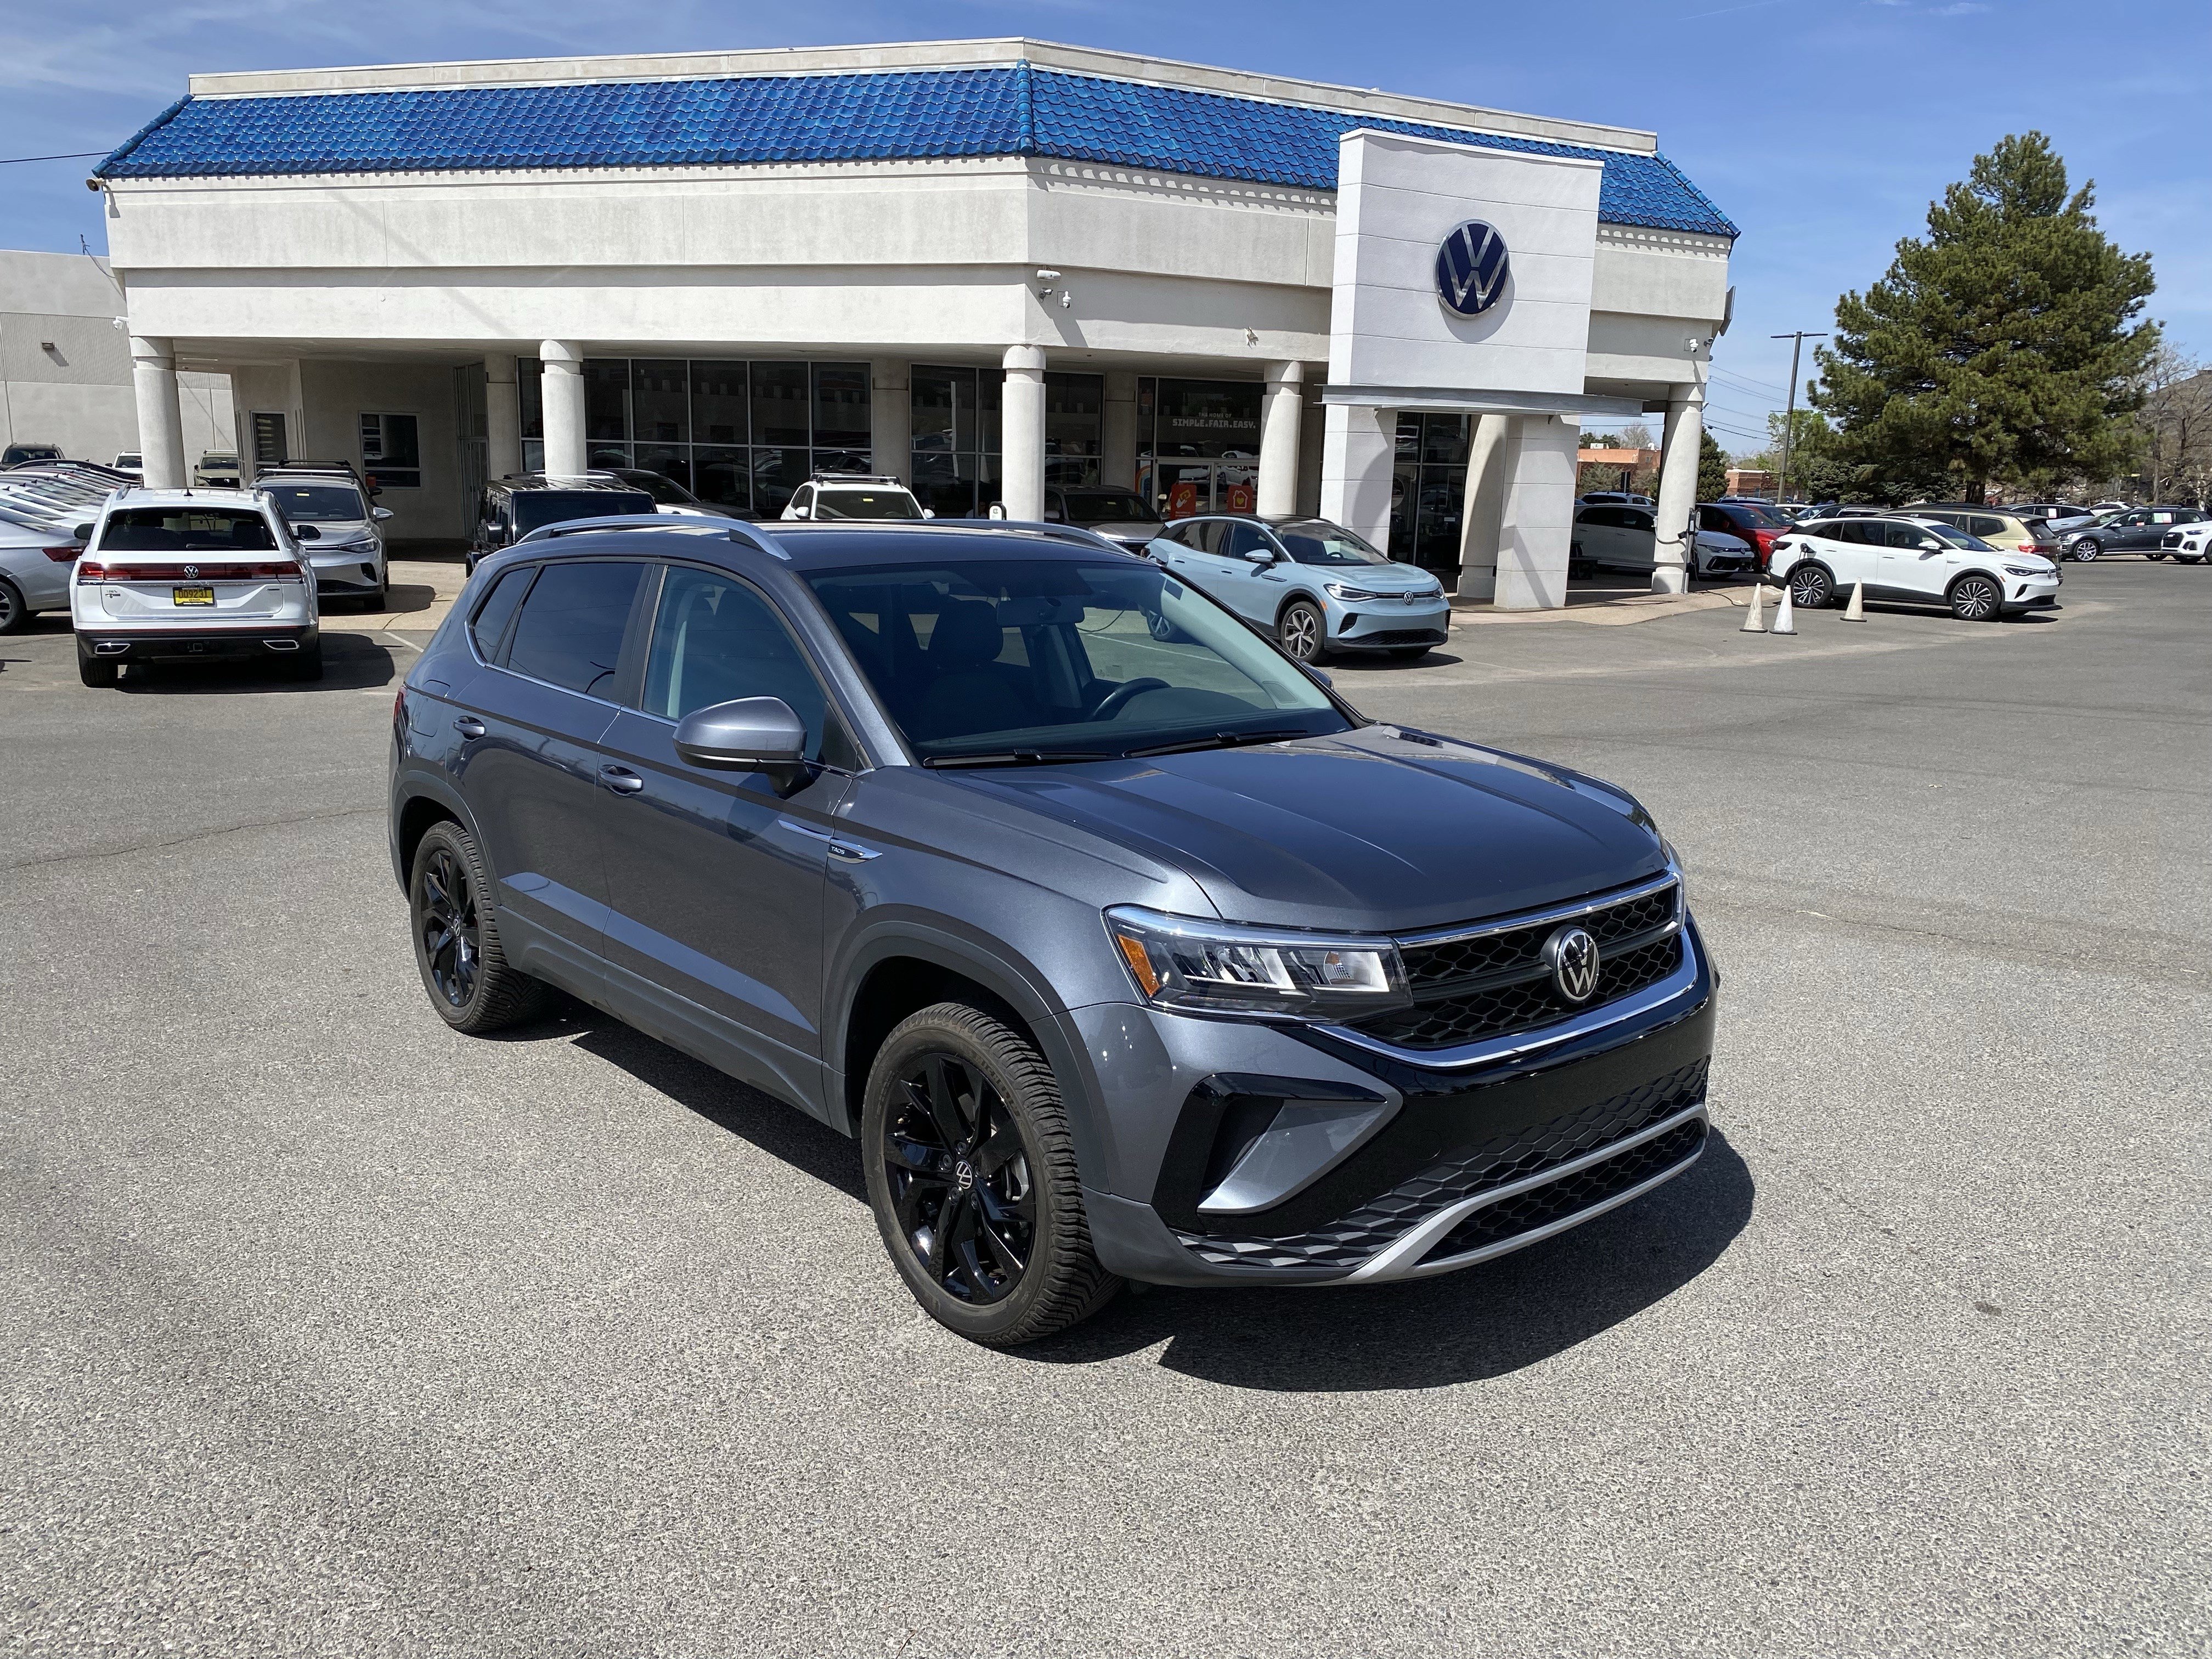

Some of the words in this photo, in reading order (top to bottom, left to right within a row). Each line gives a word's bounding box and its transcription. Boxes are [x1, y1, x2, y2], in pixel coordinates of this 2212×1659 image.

[1436, 221, 1509, 314] VW
[184, 565, 199, 578] VW
[831, 845, 845, 855] TAOS
[1560, 930, 1598, 998] VW
